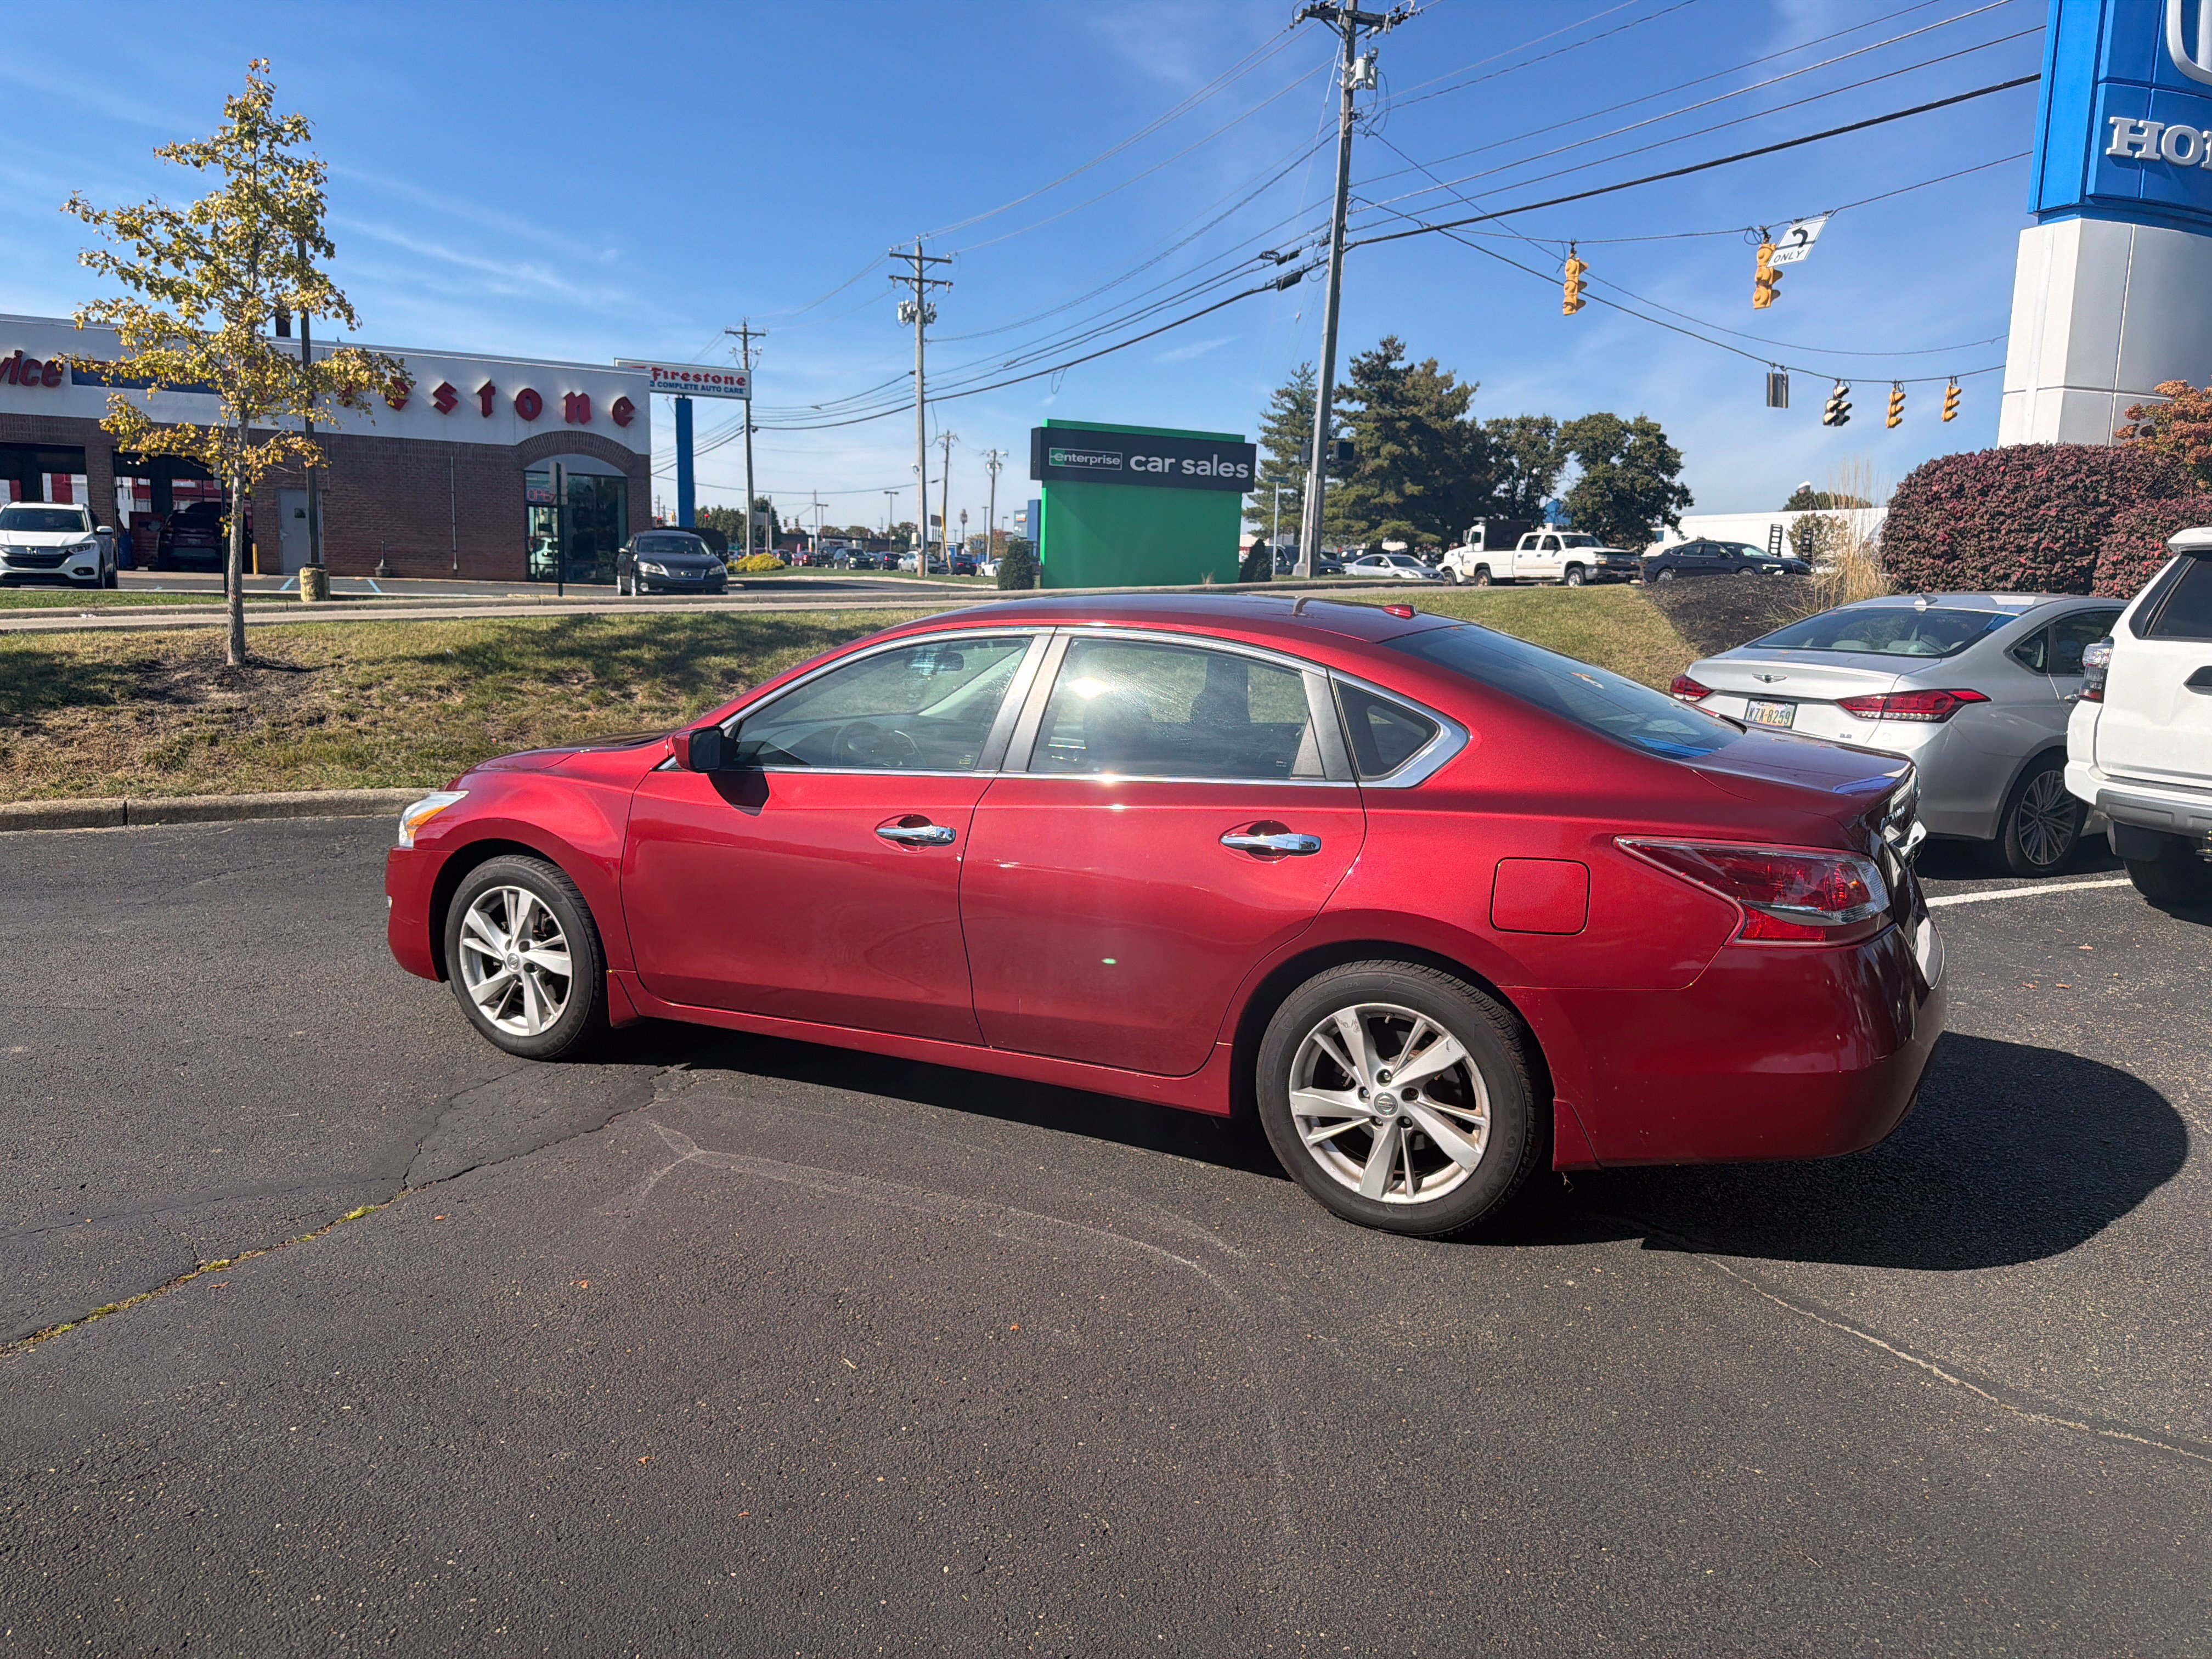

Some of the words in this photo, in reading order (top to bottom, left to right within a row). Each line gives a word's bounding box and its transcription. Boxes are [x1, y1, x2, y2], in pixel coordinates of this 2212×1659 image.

[2106, 116, 2212, 171] HO
[1773, 250, 1804, 263] ONLY
[650, 366, 747, 387] Firestone
[657, 381, 698, 391] COMPLETE
[701, 384, 722, 392] AUTO
[724, 386, 744, 394] CARE
[1053, 452, 1120, 465] enterprise
[1129, 454, 1176, 473] car
[1181, 454, 1249, 478] sales
[1767, 709, 1791, 725] 8259
